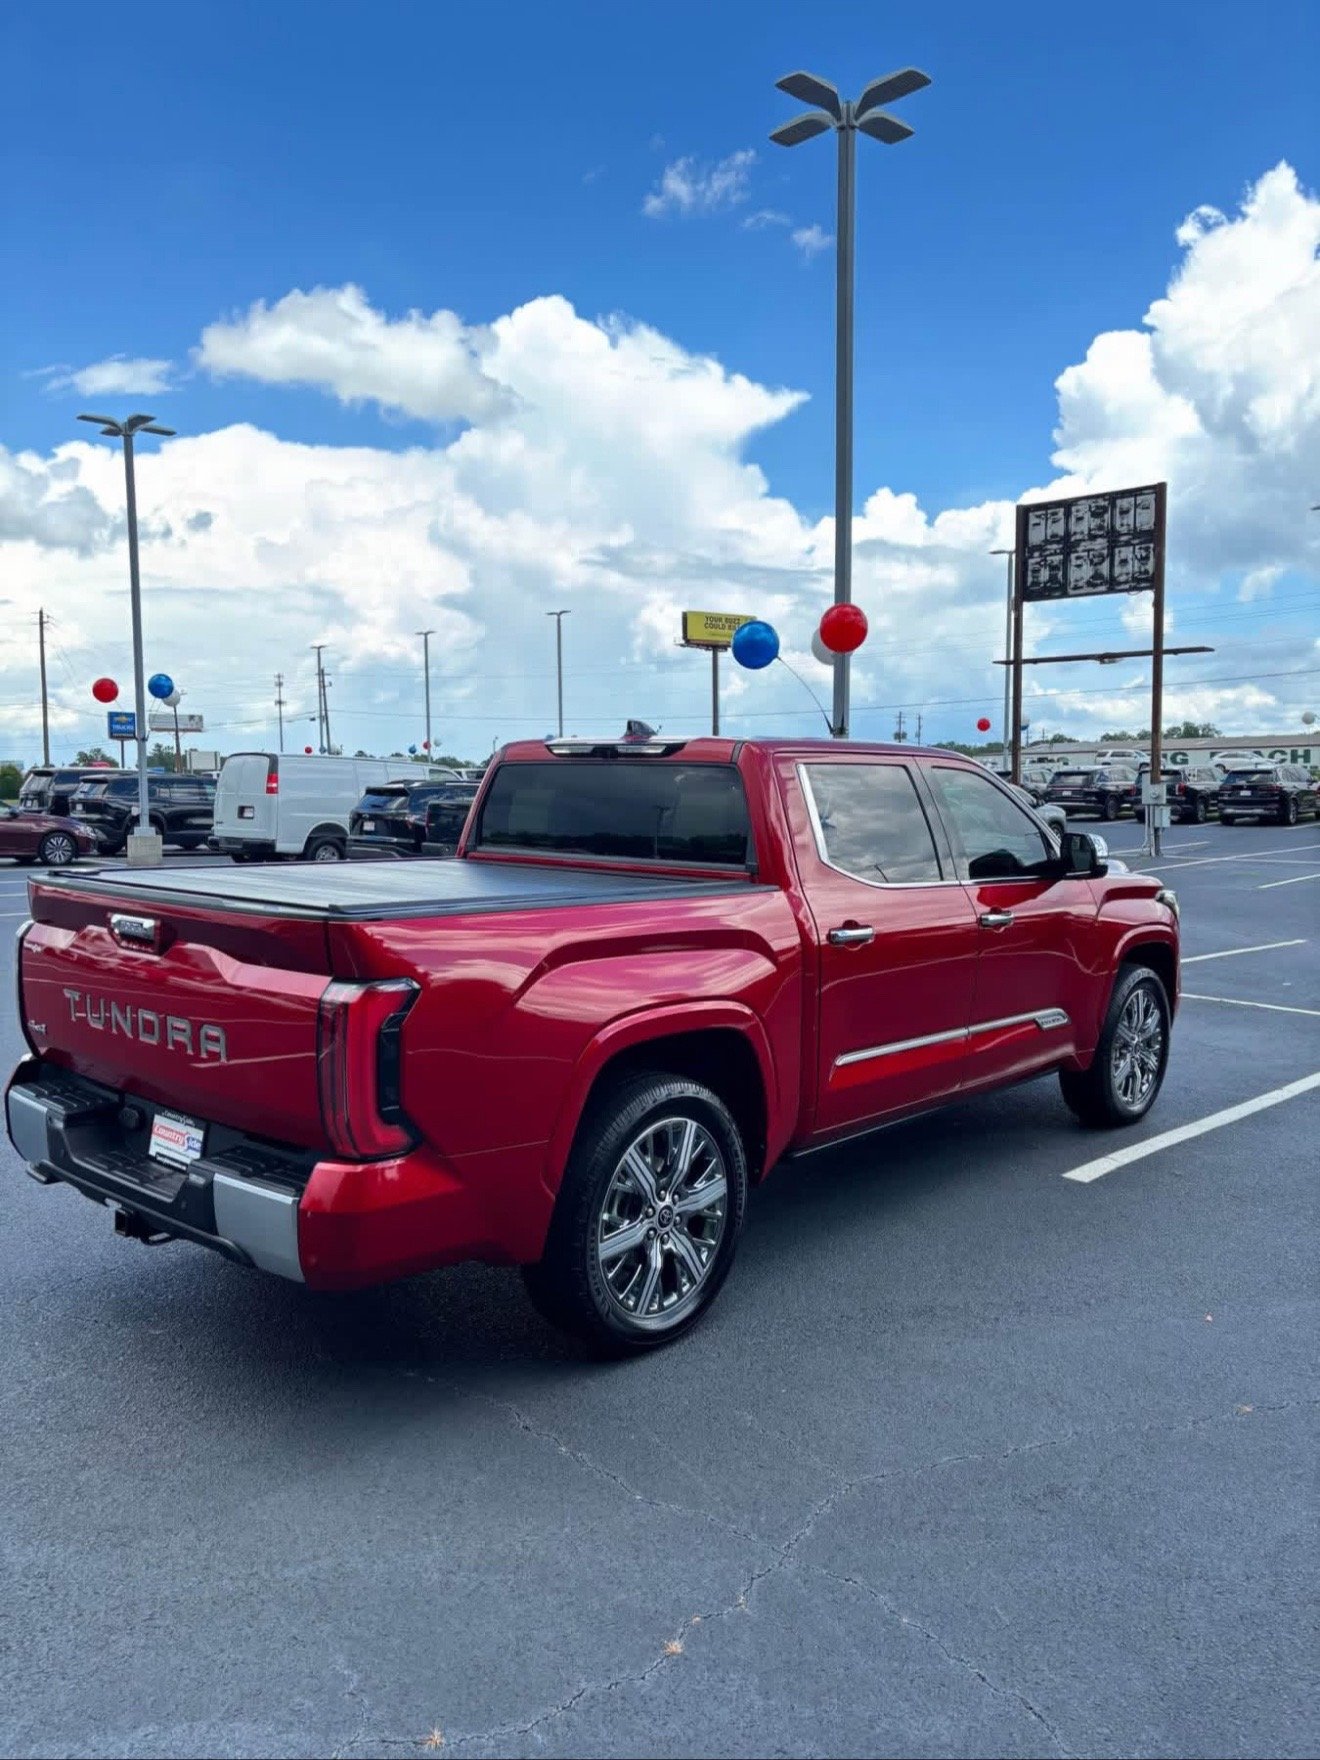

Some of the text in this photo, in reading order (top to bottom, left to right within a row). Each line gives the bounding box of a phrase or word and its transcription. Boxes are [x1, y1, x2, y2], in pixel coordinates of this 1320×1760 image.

[704, 615, 740, 625] YOUR BUZZ
[704, 622, 726, 630] COULD
[63, 988, 227, 1064] TUNDRA
